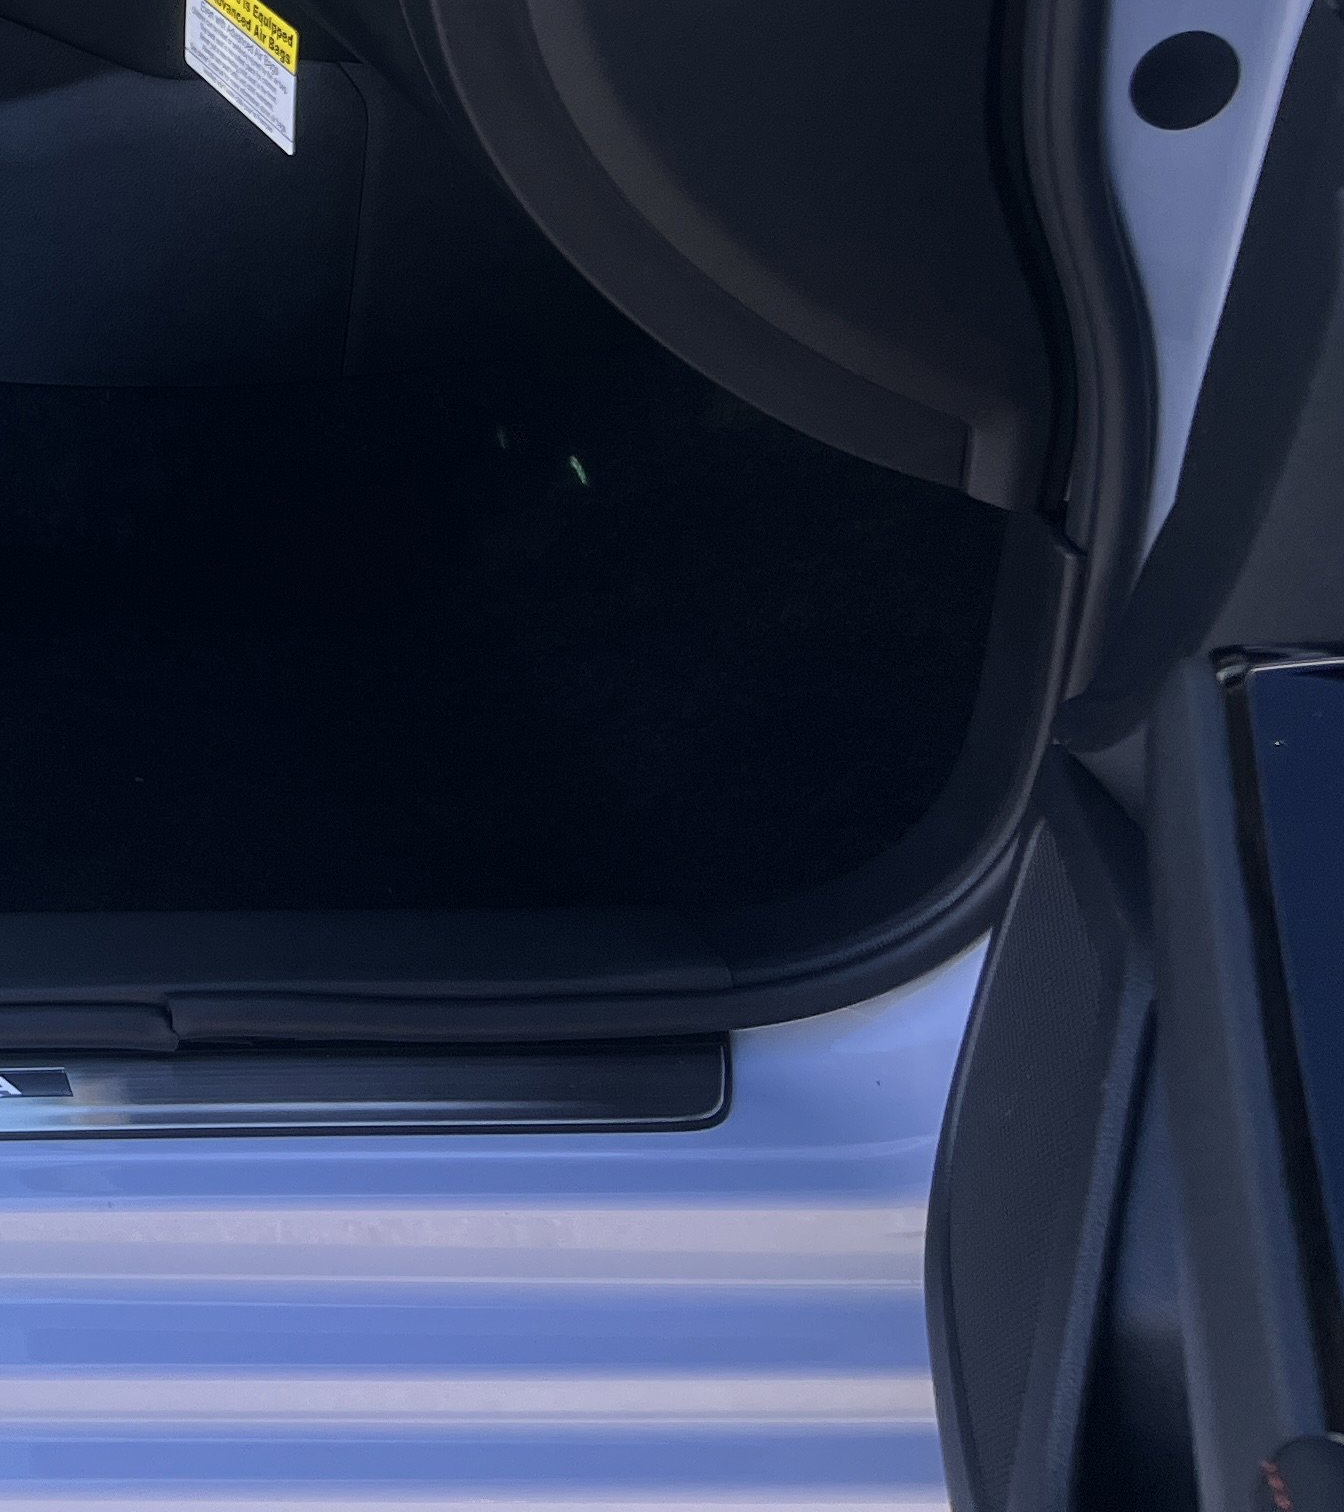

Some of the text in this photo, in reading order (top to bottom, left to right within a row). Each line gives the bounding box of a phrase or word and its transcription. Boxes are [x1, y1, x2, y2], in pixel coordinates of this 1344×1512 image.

[252, 4, 293, 48] Equipped
[254, 23, 266, 44] Air
[269, 36, 291, 65] Bags
